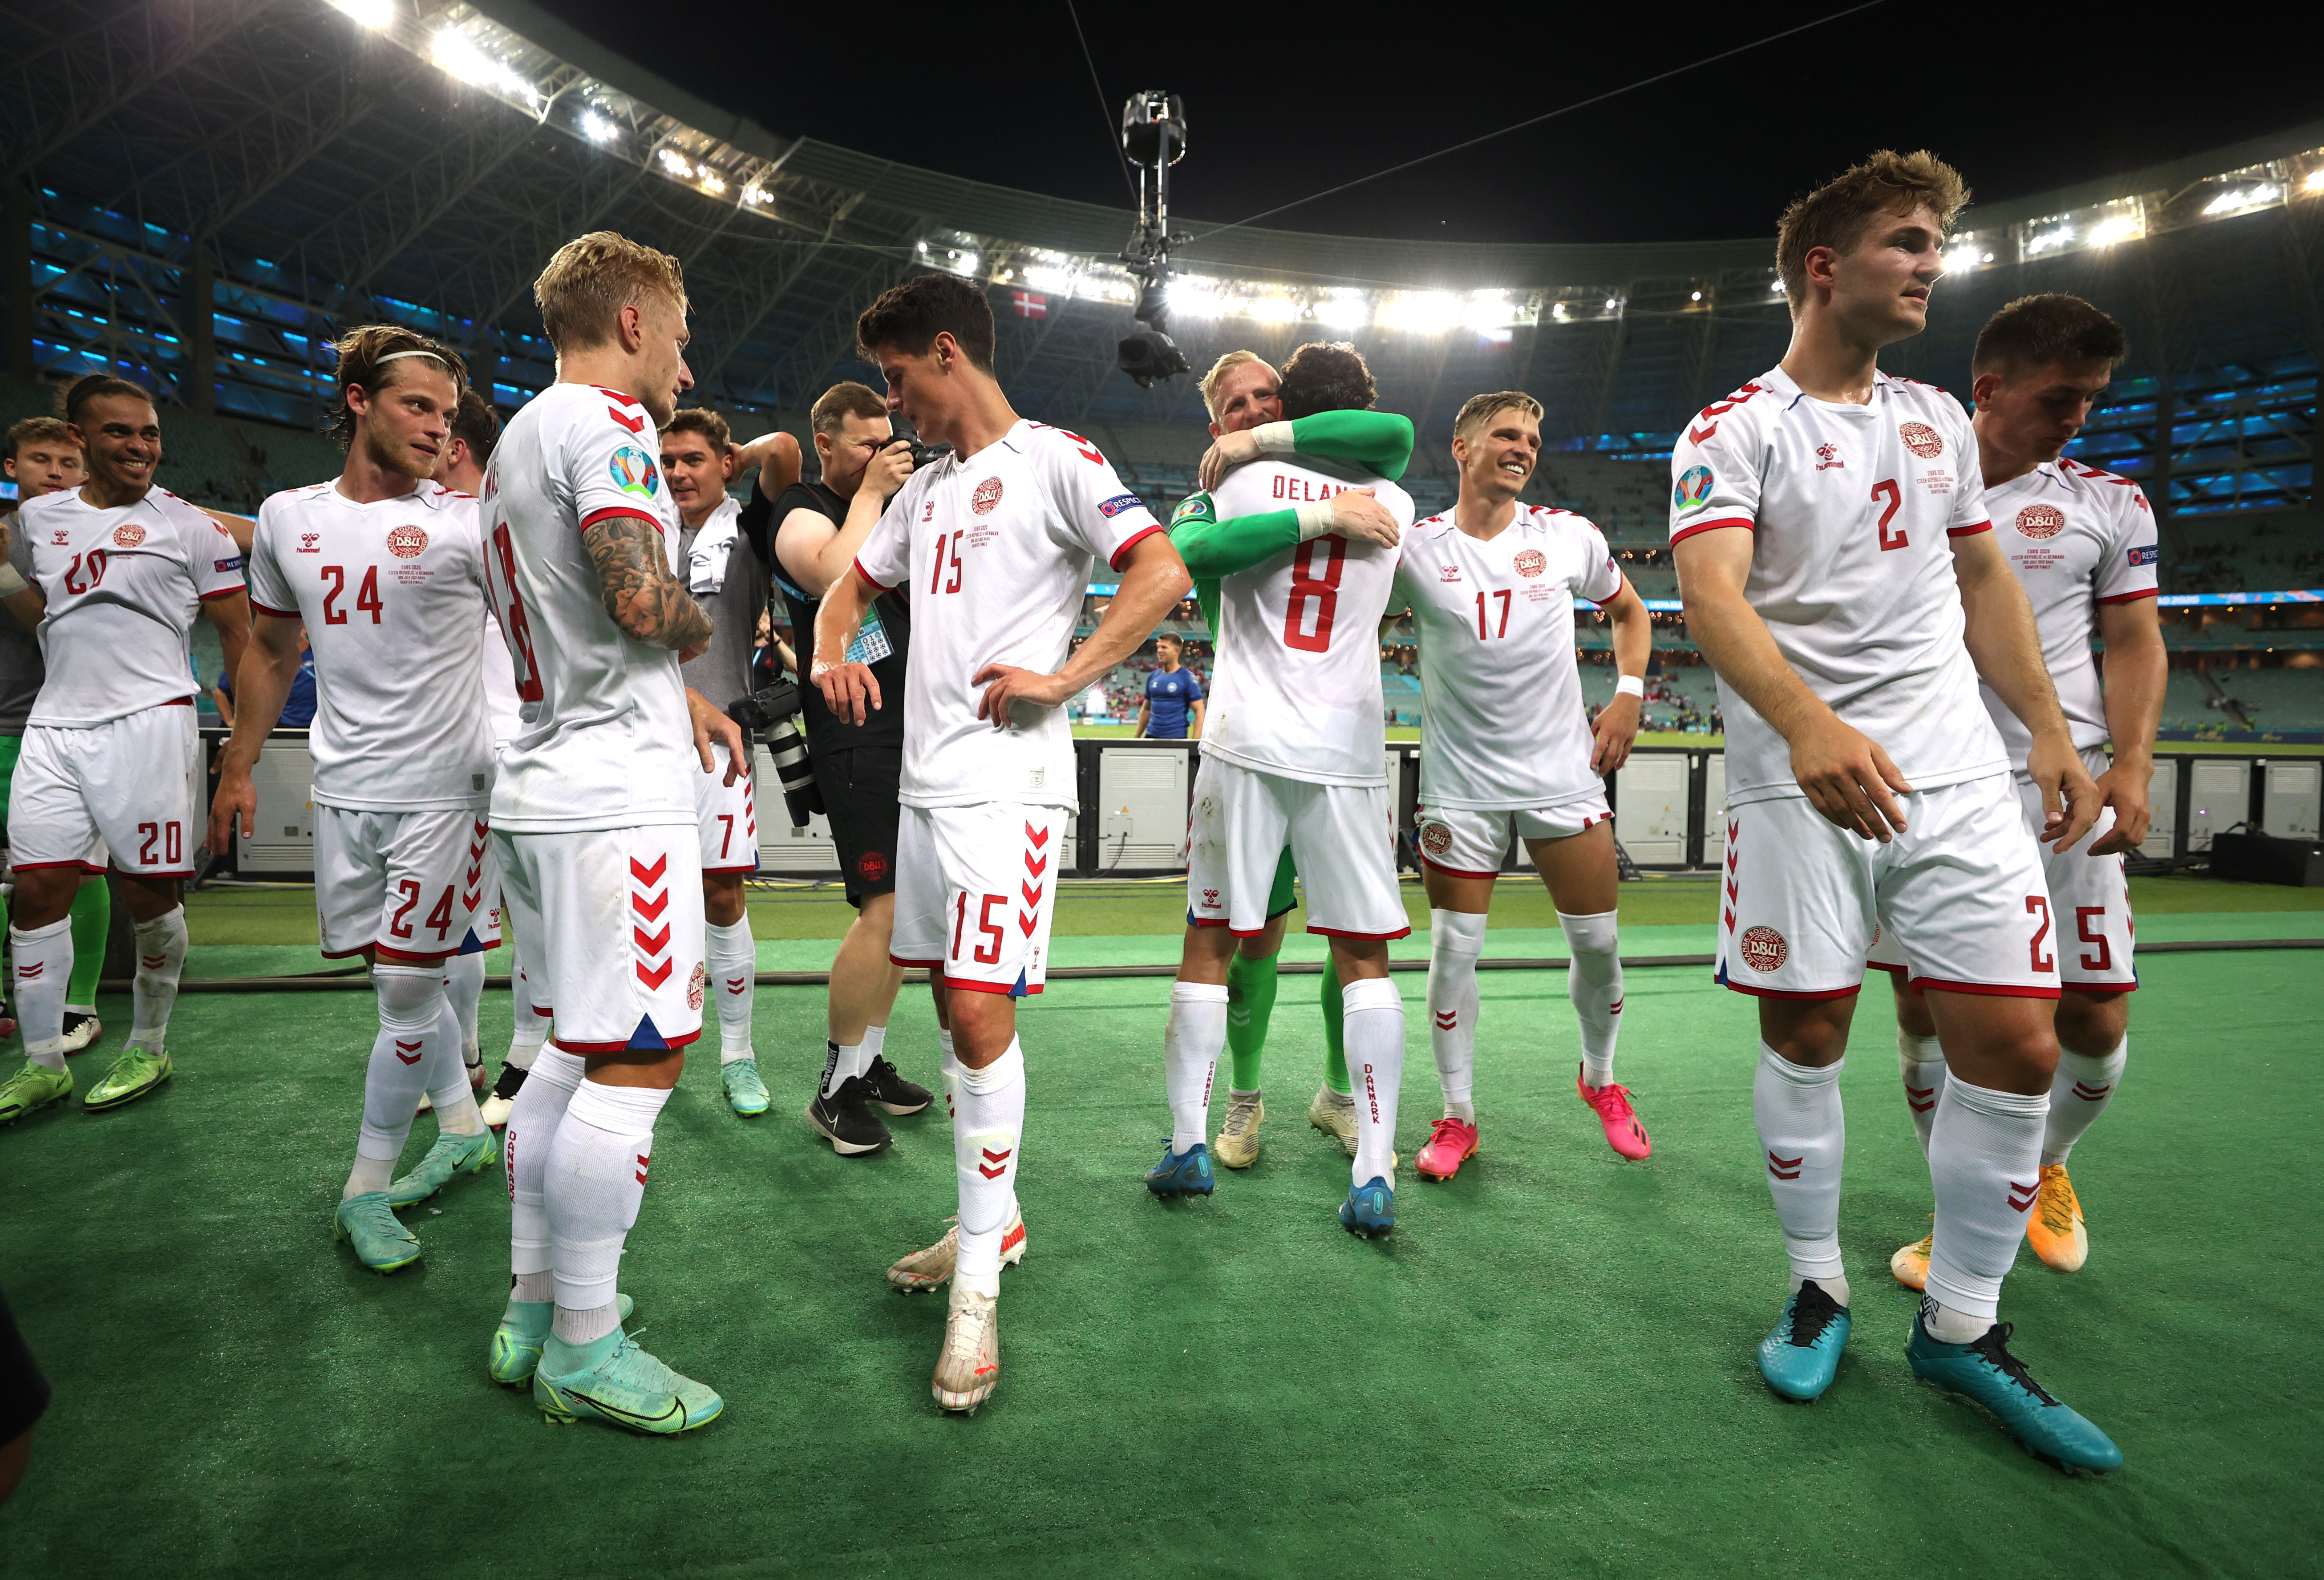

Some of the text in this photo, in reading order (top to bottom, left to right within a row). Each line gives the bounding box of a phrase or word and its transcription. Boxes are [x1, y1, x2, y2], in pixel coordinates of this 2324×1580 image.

[1906, 433, 1933, 445] DBU
[1816, 461, 1844, 471] hummel
[978, 490, 997, 503] DBU
[1273, 475, 1376, 502] DELA
[1871, 478, 1909, 551] 2
[2025, 516, 2054, 527] DBU
[120, 531, 140, 540] DBU
[388, 526, 427, 554] DANSK BOLDSPIL UNION
[395, 536, 420, 547] DBU
[2142, 550, 2158, 559] RESPE
[65, 549, 106, 595] 20
[931, 529, 964, 594] 15
[1520, 558, 1540, 569] DBU
[320, 565, 384, 625] 24
[1283, 535, 1347, 653] 8
[1475, 588, 1512, 640] 17
[138, 821, 181, 865] 20
[717, 814, 734, 859] 7
[1428, 831, 1446, 845] DBU
[863, 861, 882, 871] DBU
[390, 879, 455, 941] 24
[952, 891, 1008, 965] 15
[1742, 928, 1786, 967] DANSK BOLDSPIL UNION
[1750, 941, 1778, 956] DBU
[2025, 895, 2054, 973] 2
[2076, 907, 2111, 970] 5
[690, 977, 701, 995] DBU
[1203, 1061, 1214, 1107] DANMARK
[1364, 1064, 1380, 1124] DANMARK
[508, 1130, 517, 1204] DANMARK
